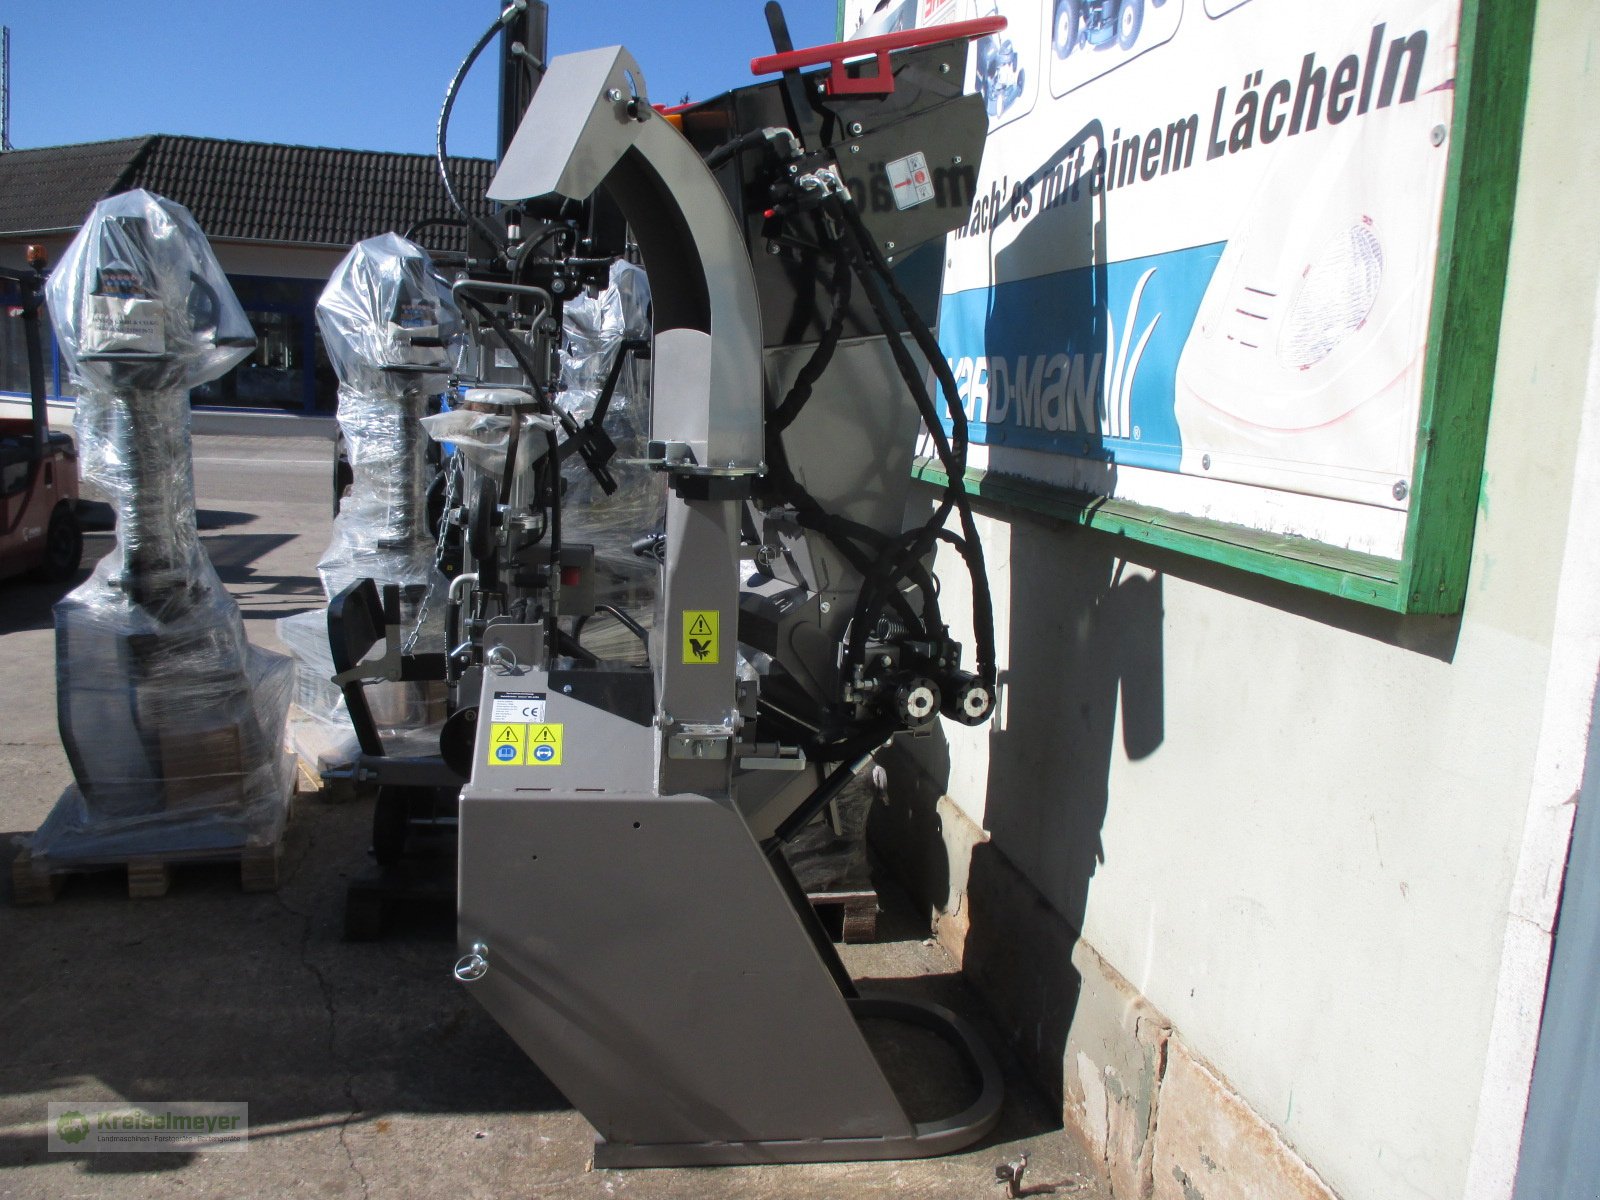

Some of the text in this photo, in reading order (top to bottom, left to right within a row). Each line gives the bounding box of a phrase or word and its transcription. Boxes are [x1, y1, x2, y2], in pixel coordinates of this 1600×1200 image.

[1011, 176, 1034, 222] es
[1039, 144, 1085, 213] mit
[1089, 114, 1198, 197] einem
[1207, 22, 1428, 161] Lächeln
[522, 707, 539, 717] CE
